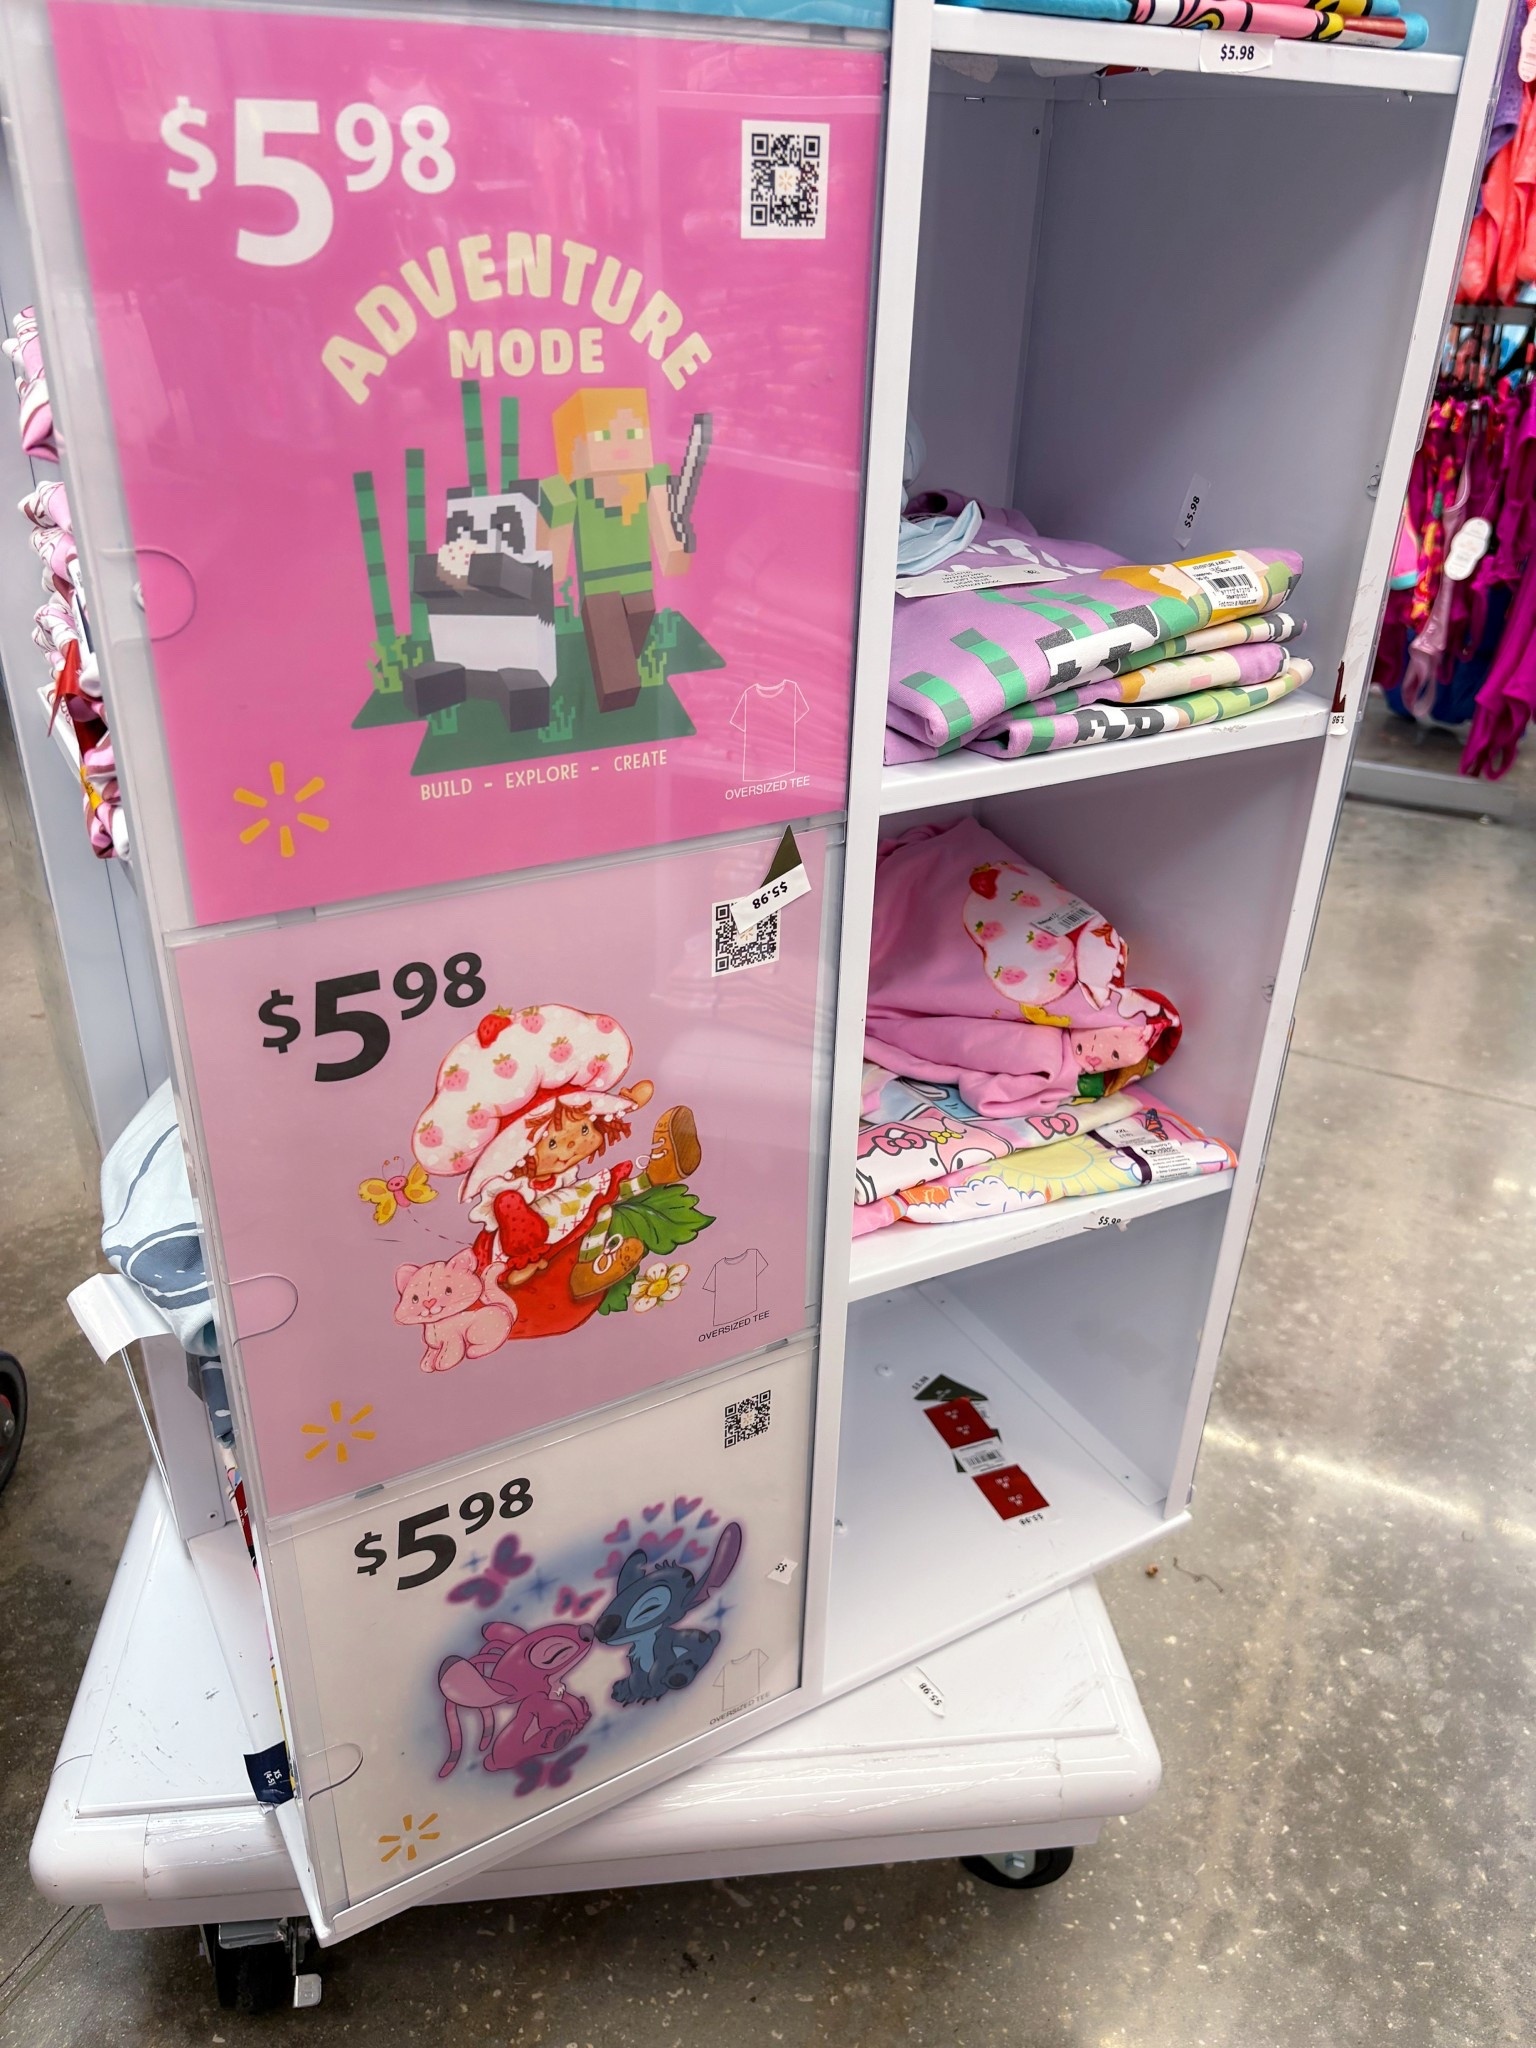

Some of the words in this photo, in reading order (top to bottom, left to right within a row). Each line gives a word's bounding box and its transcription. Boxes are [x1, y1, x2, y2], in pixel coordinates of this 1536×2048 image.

[1220, 43, 1255, 61] $5.98
[320, 231, 712, 405] ADVENTURE
[448, 327, 604, 378] MODE
[1184, 495, 1200, 528] $5.98
[420, 778, 472, 800] BUILD
[505, 763, 579, 789] EXPLORE
[614, 749, 667, 772] CREATE
[725, 780, 787, 800] OVERSIZED
[790, 775, 810, 789] TEE
[752, 881, 788, 909] $5.98
[698, 1317, 751, 1342] OVERSIZED
[753, 1310, 770, 1322] TEE
[709, 1699, 755, 1725] OVERSIZED
[757, 1691, 771, 1702] TEE
[919, 1682, 943, 1706] $5.98
[273, 1769, 282, 1779] XS
